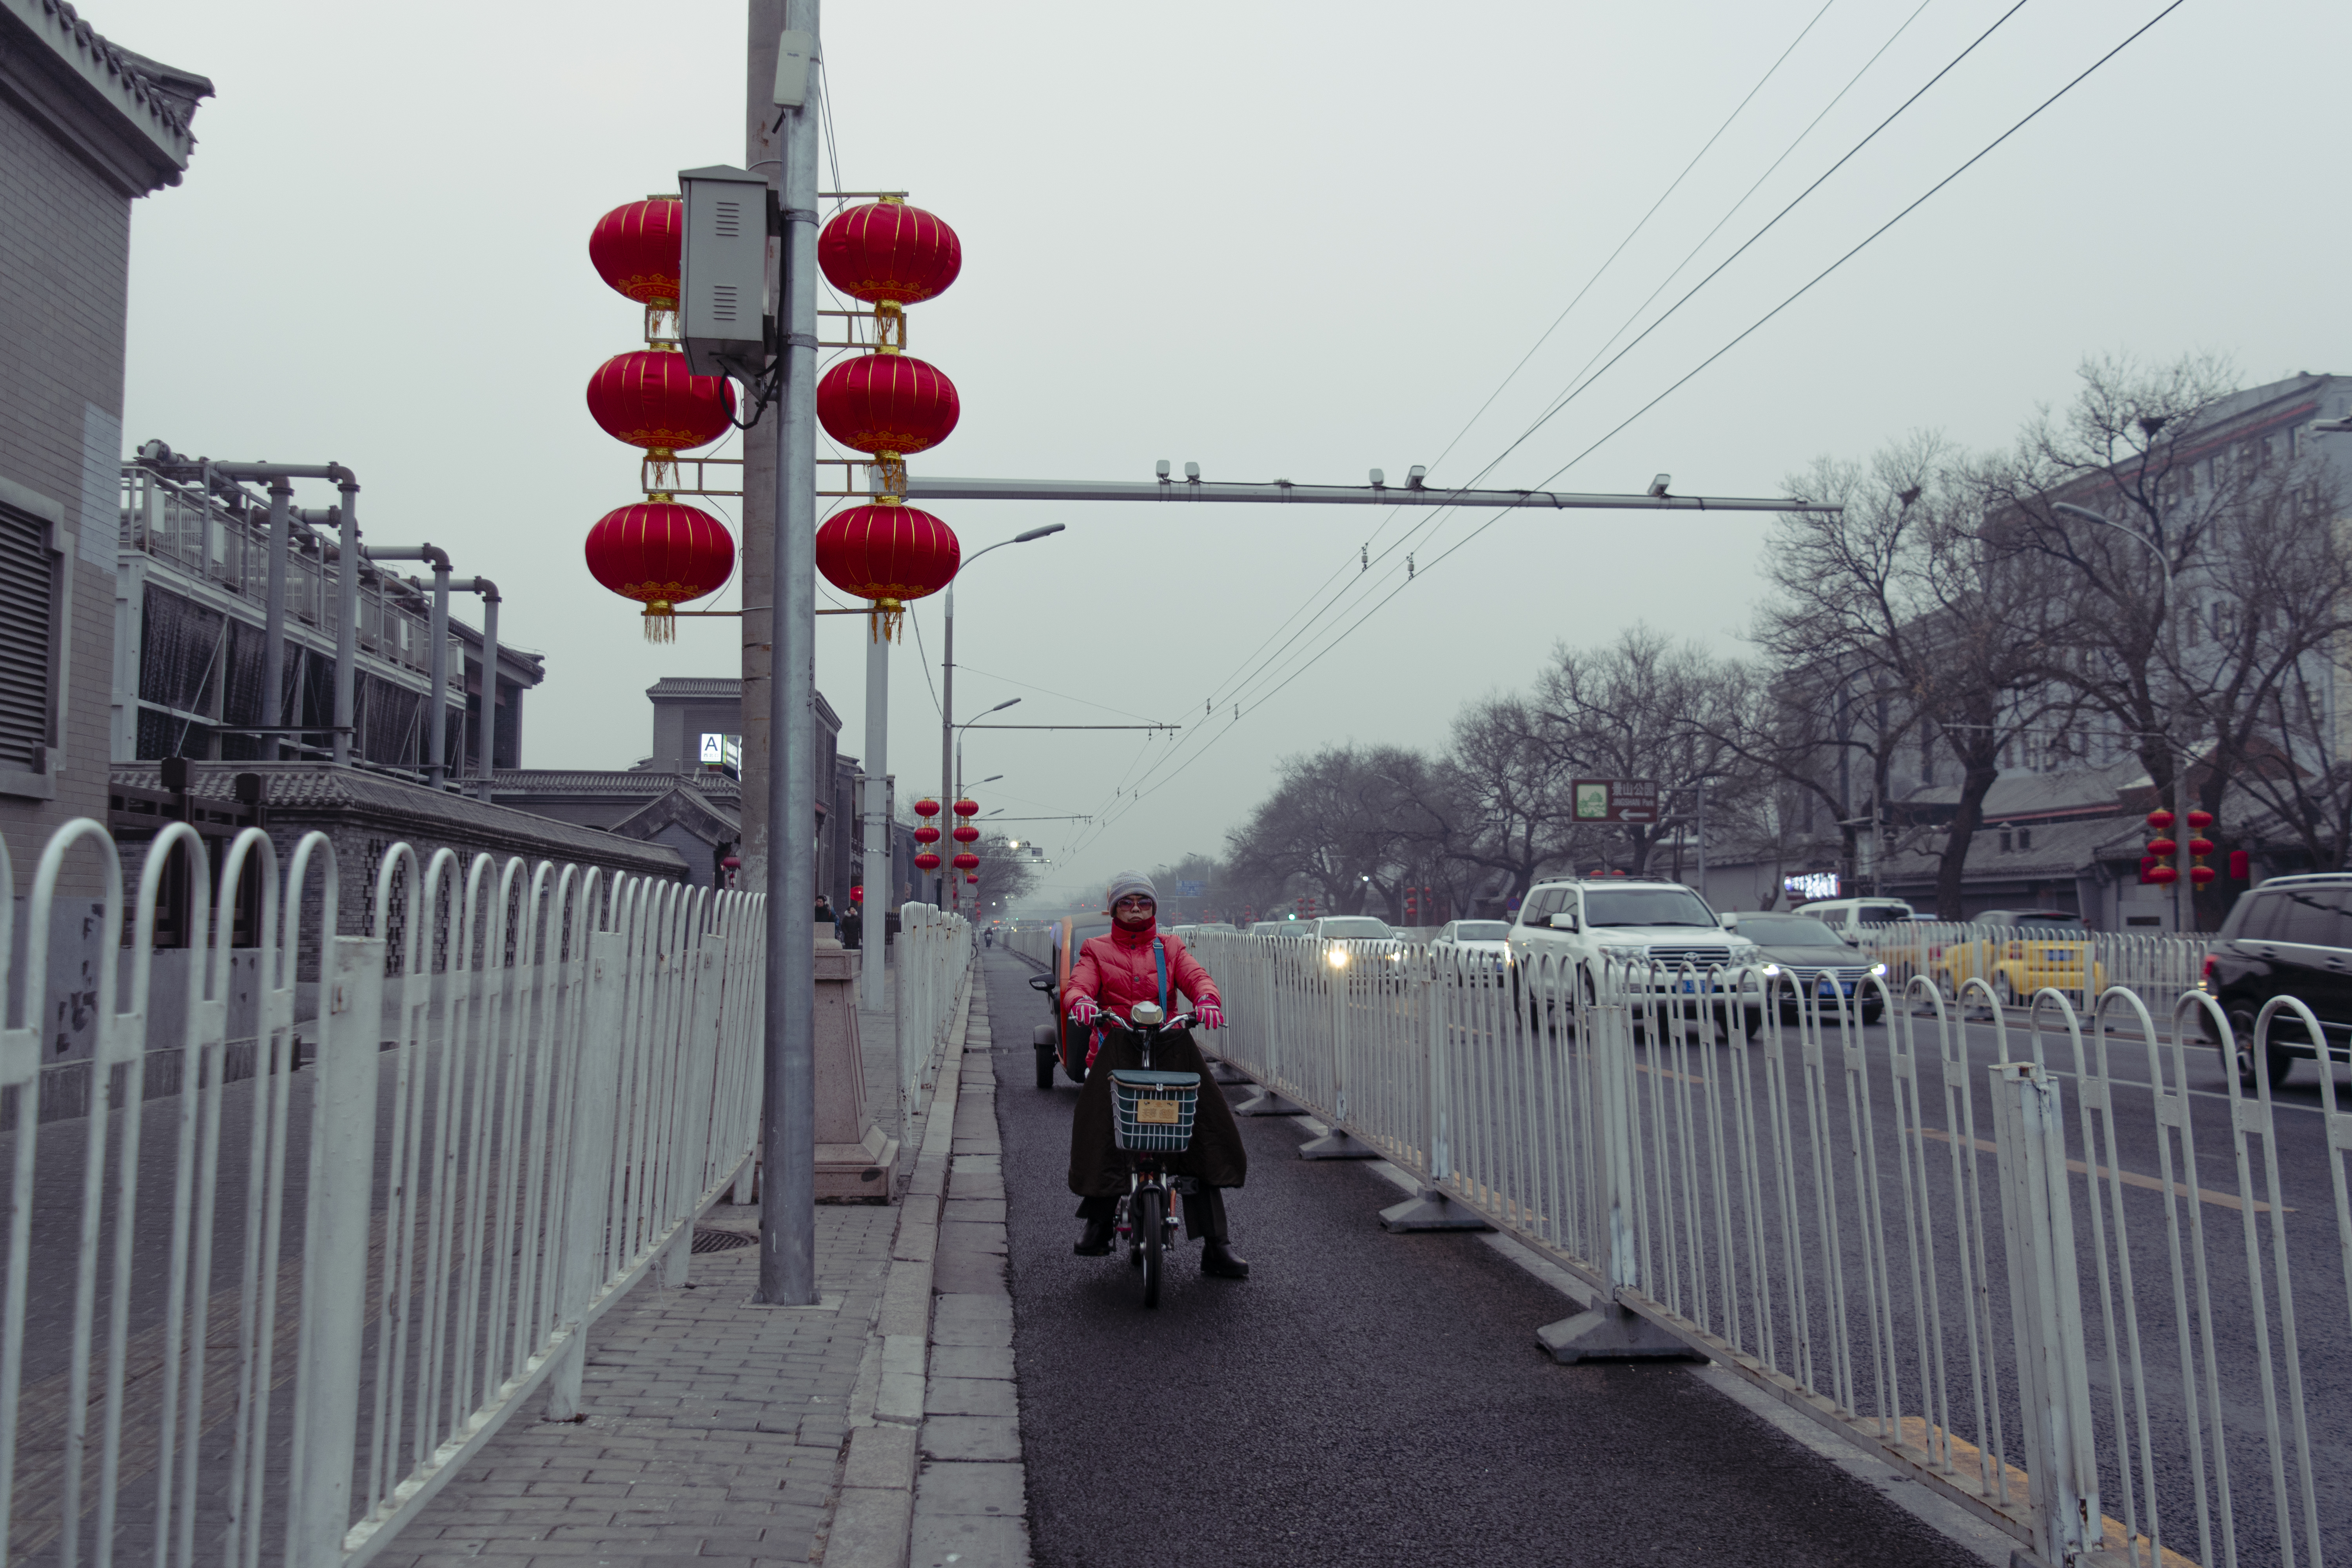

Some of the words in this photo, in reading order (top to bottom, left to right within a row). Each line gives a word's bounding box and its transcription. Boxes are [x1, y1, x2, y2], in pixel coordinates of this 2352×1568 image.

[704, 736, 718, 751] A
[1612, 781, 1654, 796] 景山公园
